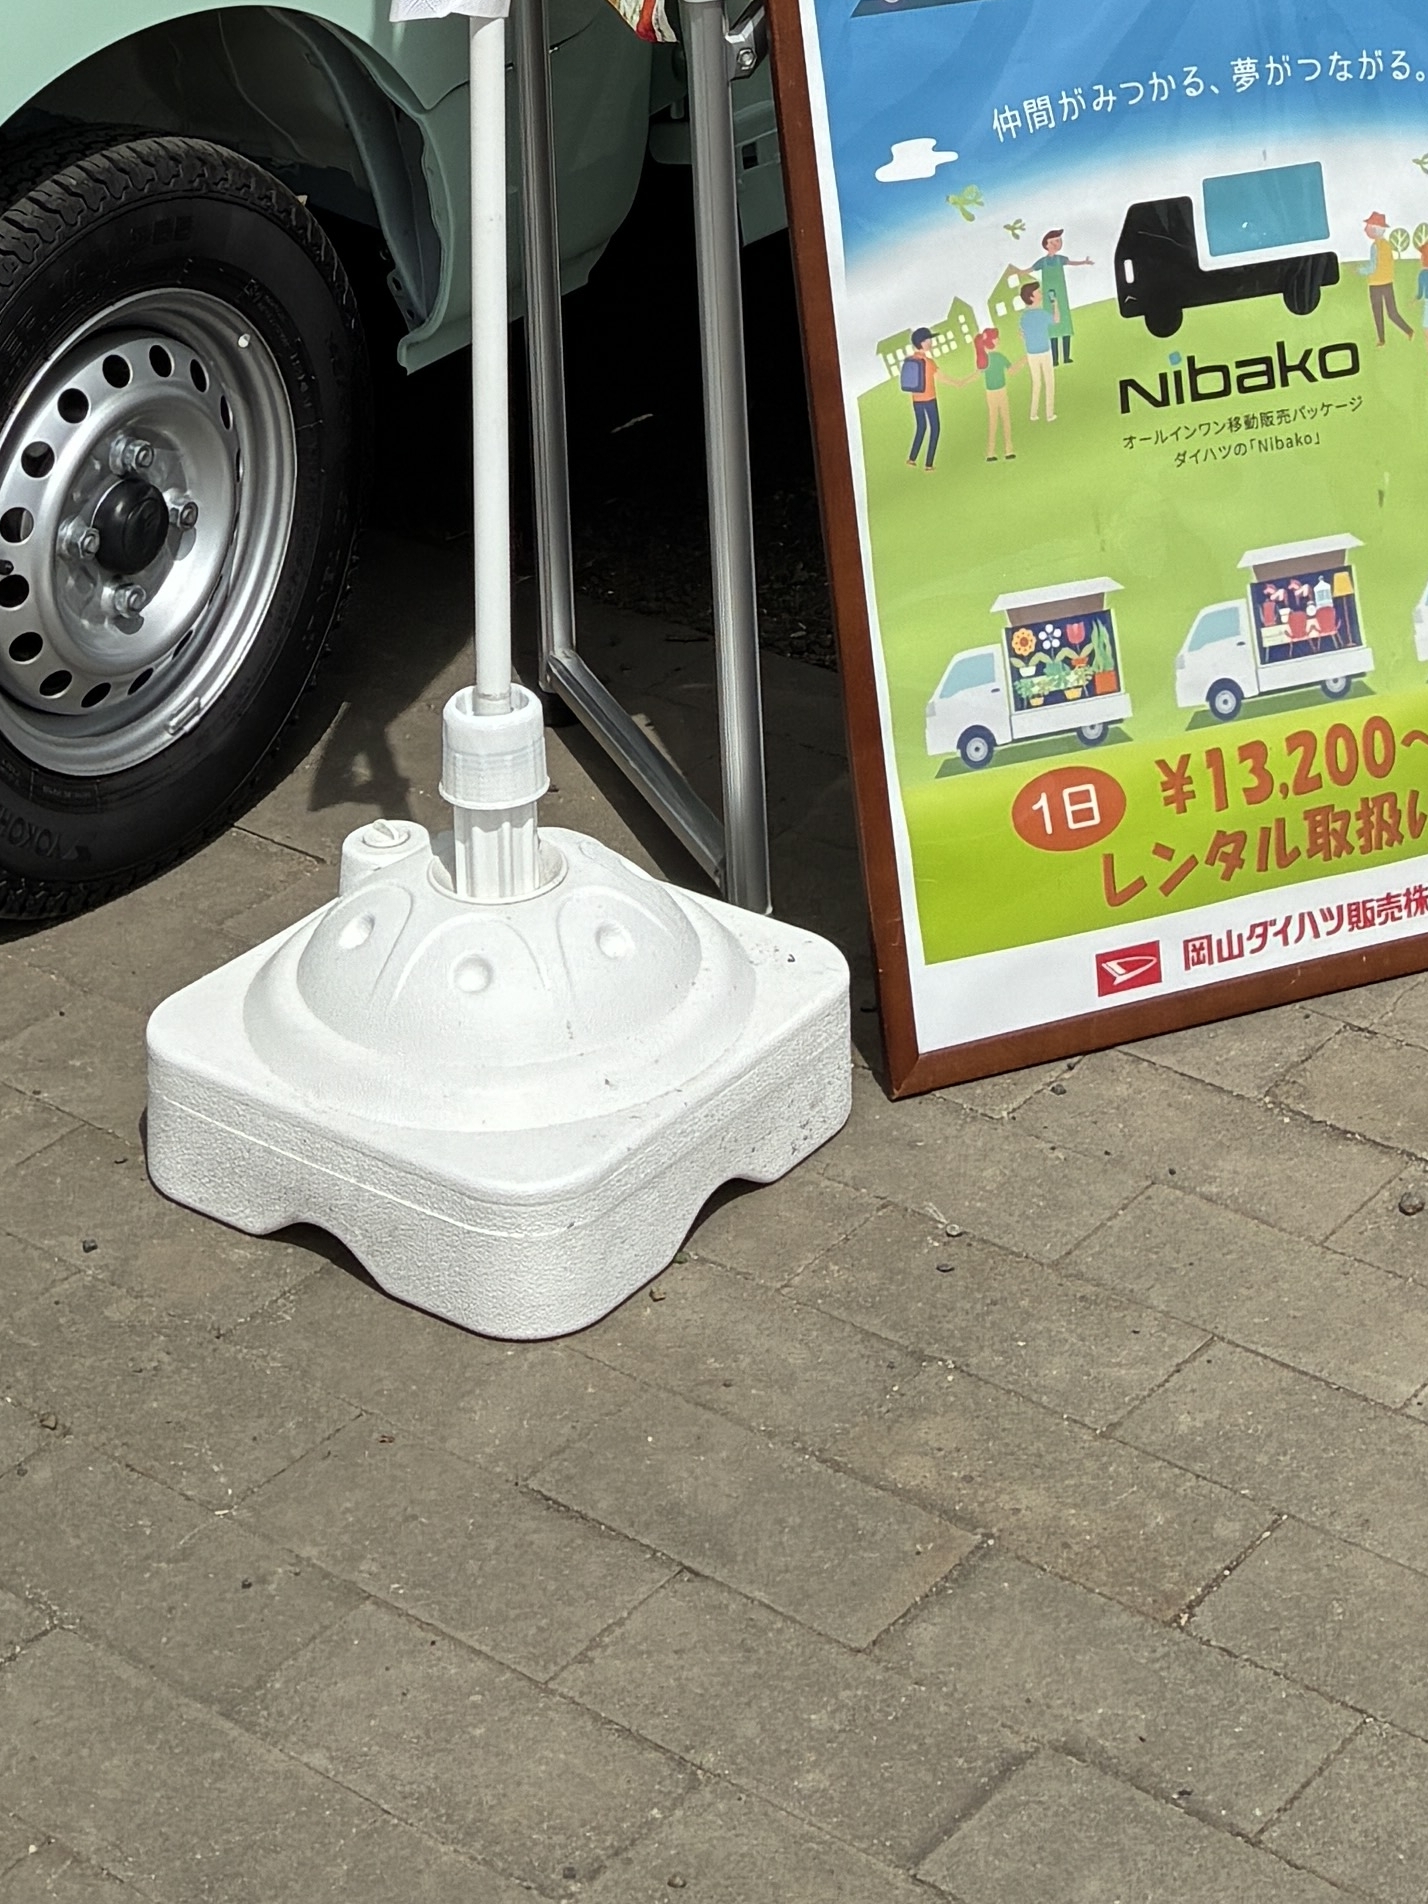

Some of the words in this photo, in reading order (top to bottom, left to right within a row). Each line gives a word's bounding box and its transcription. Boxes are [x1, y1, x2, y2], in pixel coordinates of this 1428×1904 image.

[991, 48, 1428, 144] 仲間がみつかる、夢がつながる。
[1119, 340, 1361, 415] Nibako
[1122, 395, 1364, 451] オールインワン移動販売パッケージ
[1173, 431, 1322, 469] ダイハツの「Nibako」
[1031, 782, 1102, 837] 1日
